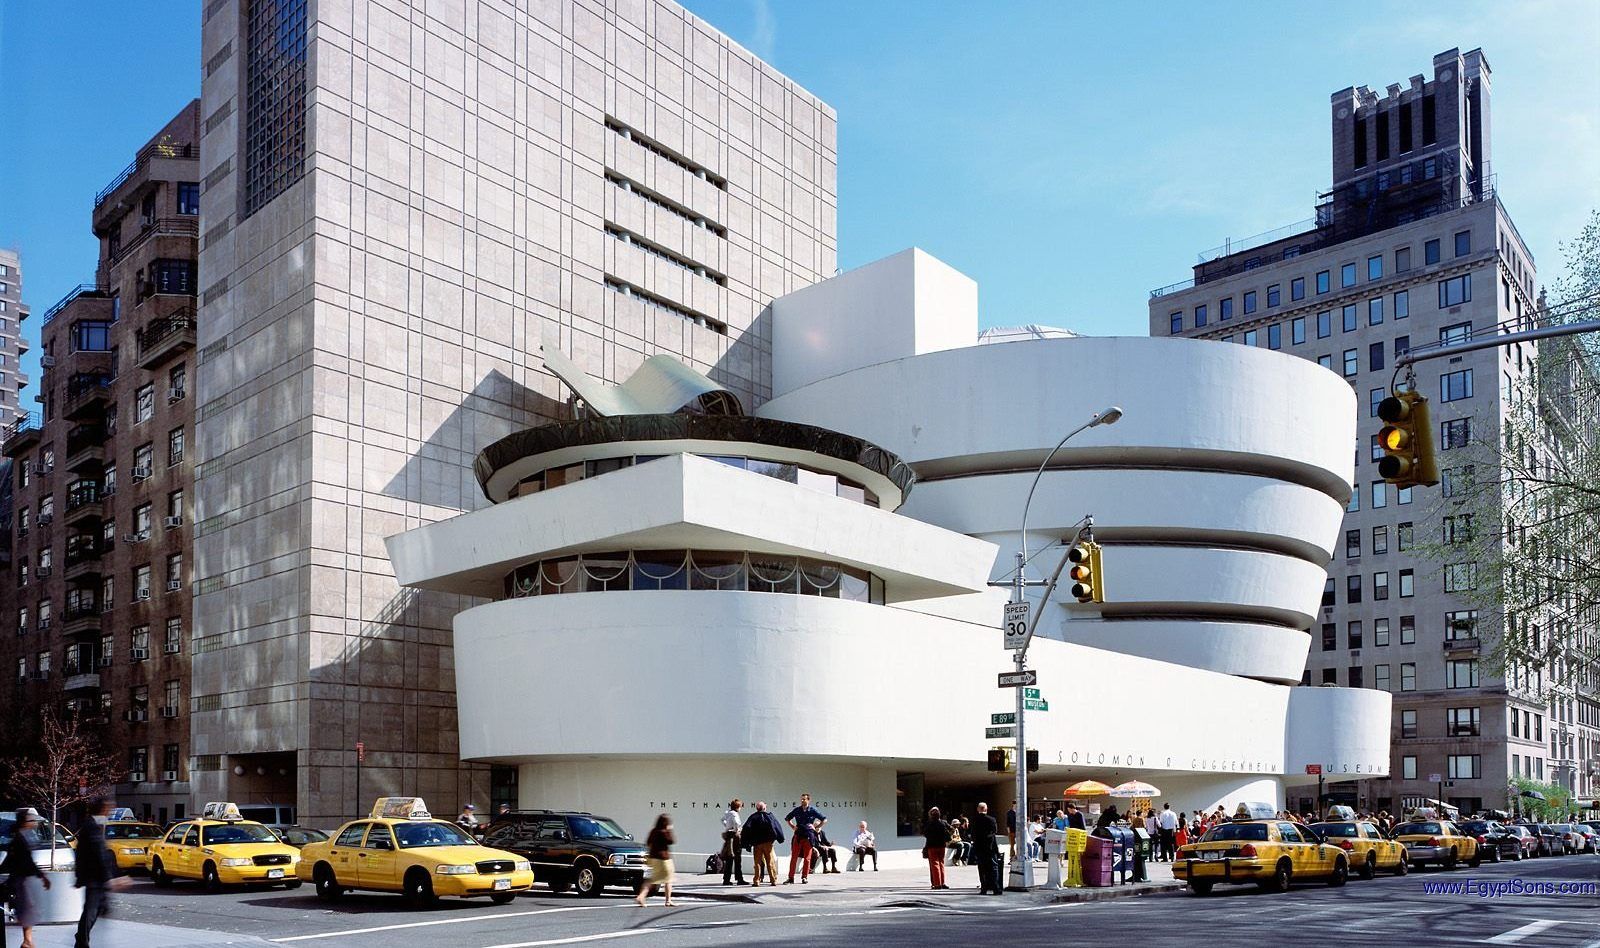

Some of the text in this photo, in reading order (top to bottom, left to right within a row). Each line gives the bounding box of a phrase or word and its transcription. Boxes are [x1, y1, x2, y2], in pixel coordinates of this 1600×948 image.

[1006, 606, 1028, 614] SPEED
[1007, 622, 1026, 636] 30
[1027, 689, 1032, 698] 5
[993, 715, 998, 723] E
[1058, 750, 1144, 766] SOLOMON
[1191, 758, 1277, 772] GUGGENHEIM
[1305, 764, 1382, 774] USEUM
